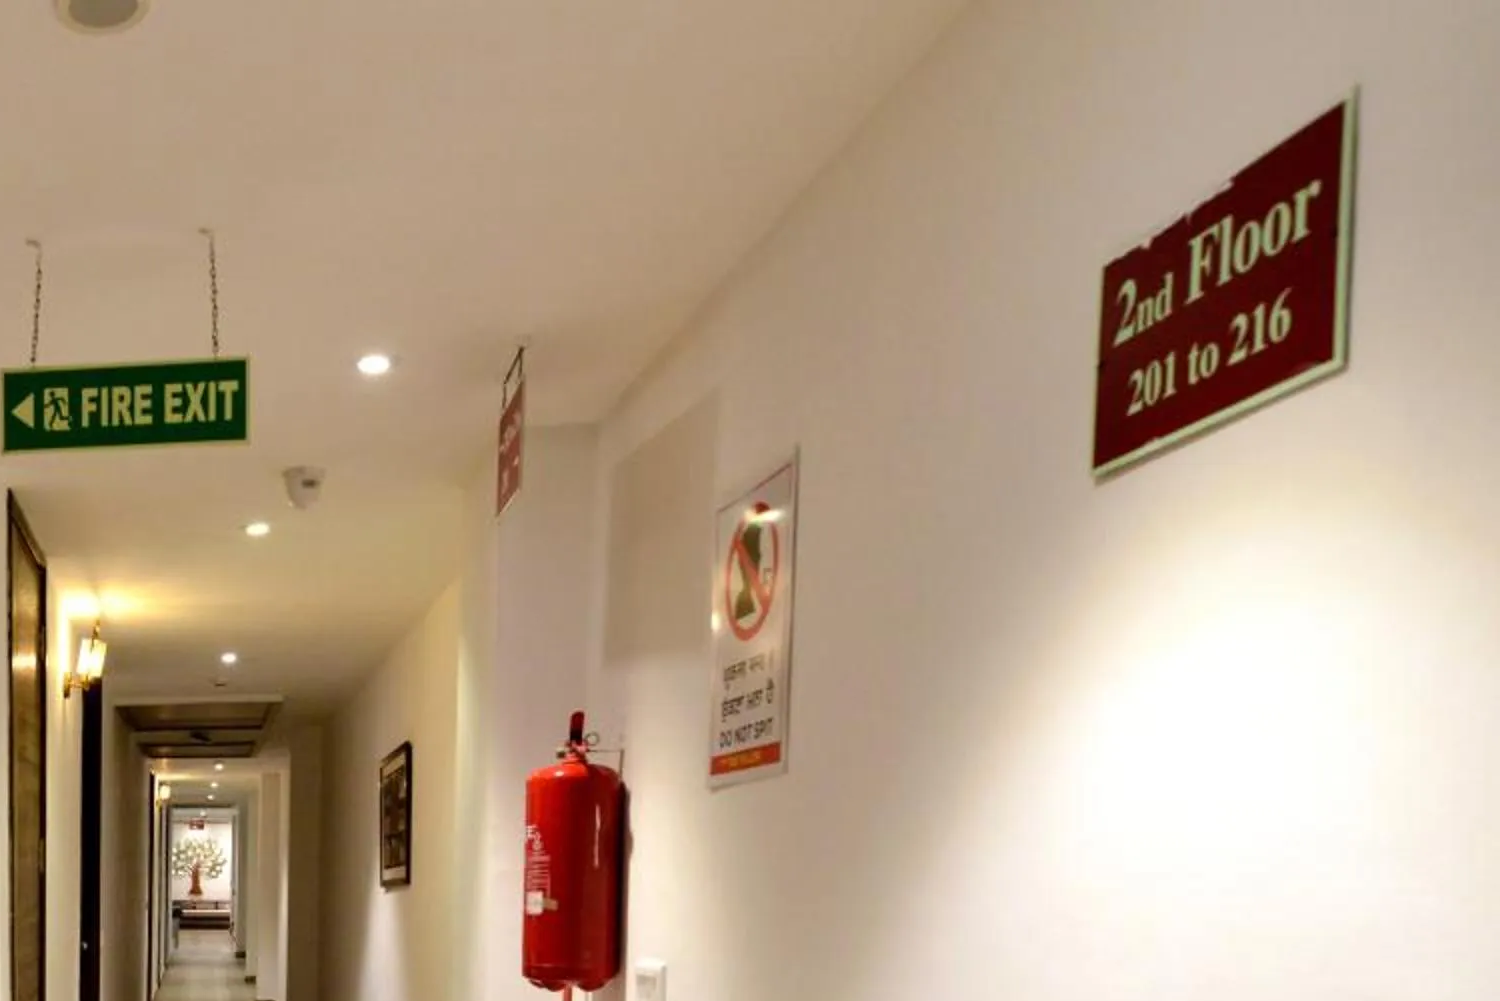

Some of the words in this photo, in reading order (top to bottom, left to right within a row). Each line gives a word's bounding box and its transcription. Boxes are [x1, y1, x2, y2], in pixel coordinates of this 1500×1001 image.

[1112, 271, 1174, 348] 2nd
[1184, 178, 1323, 306] Floor
[80, 383, 153, 428] FIRE
[163, 379, 239, 424] EXIT
[1126, 351, 1178, 417] 201
[1188, 342, 1220, 386] to
[1227, 286, 1293, 367] 216
